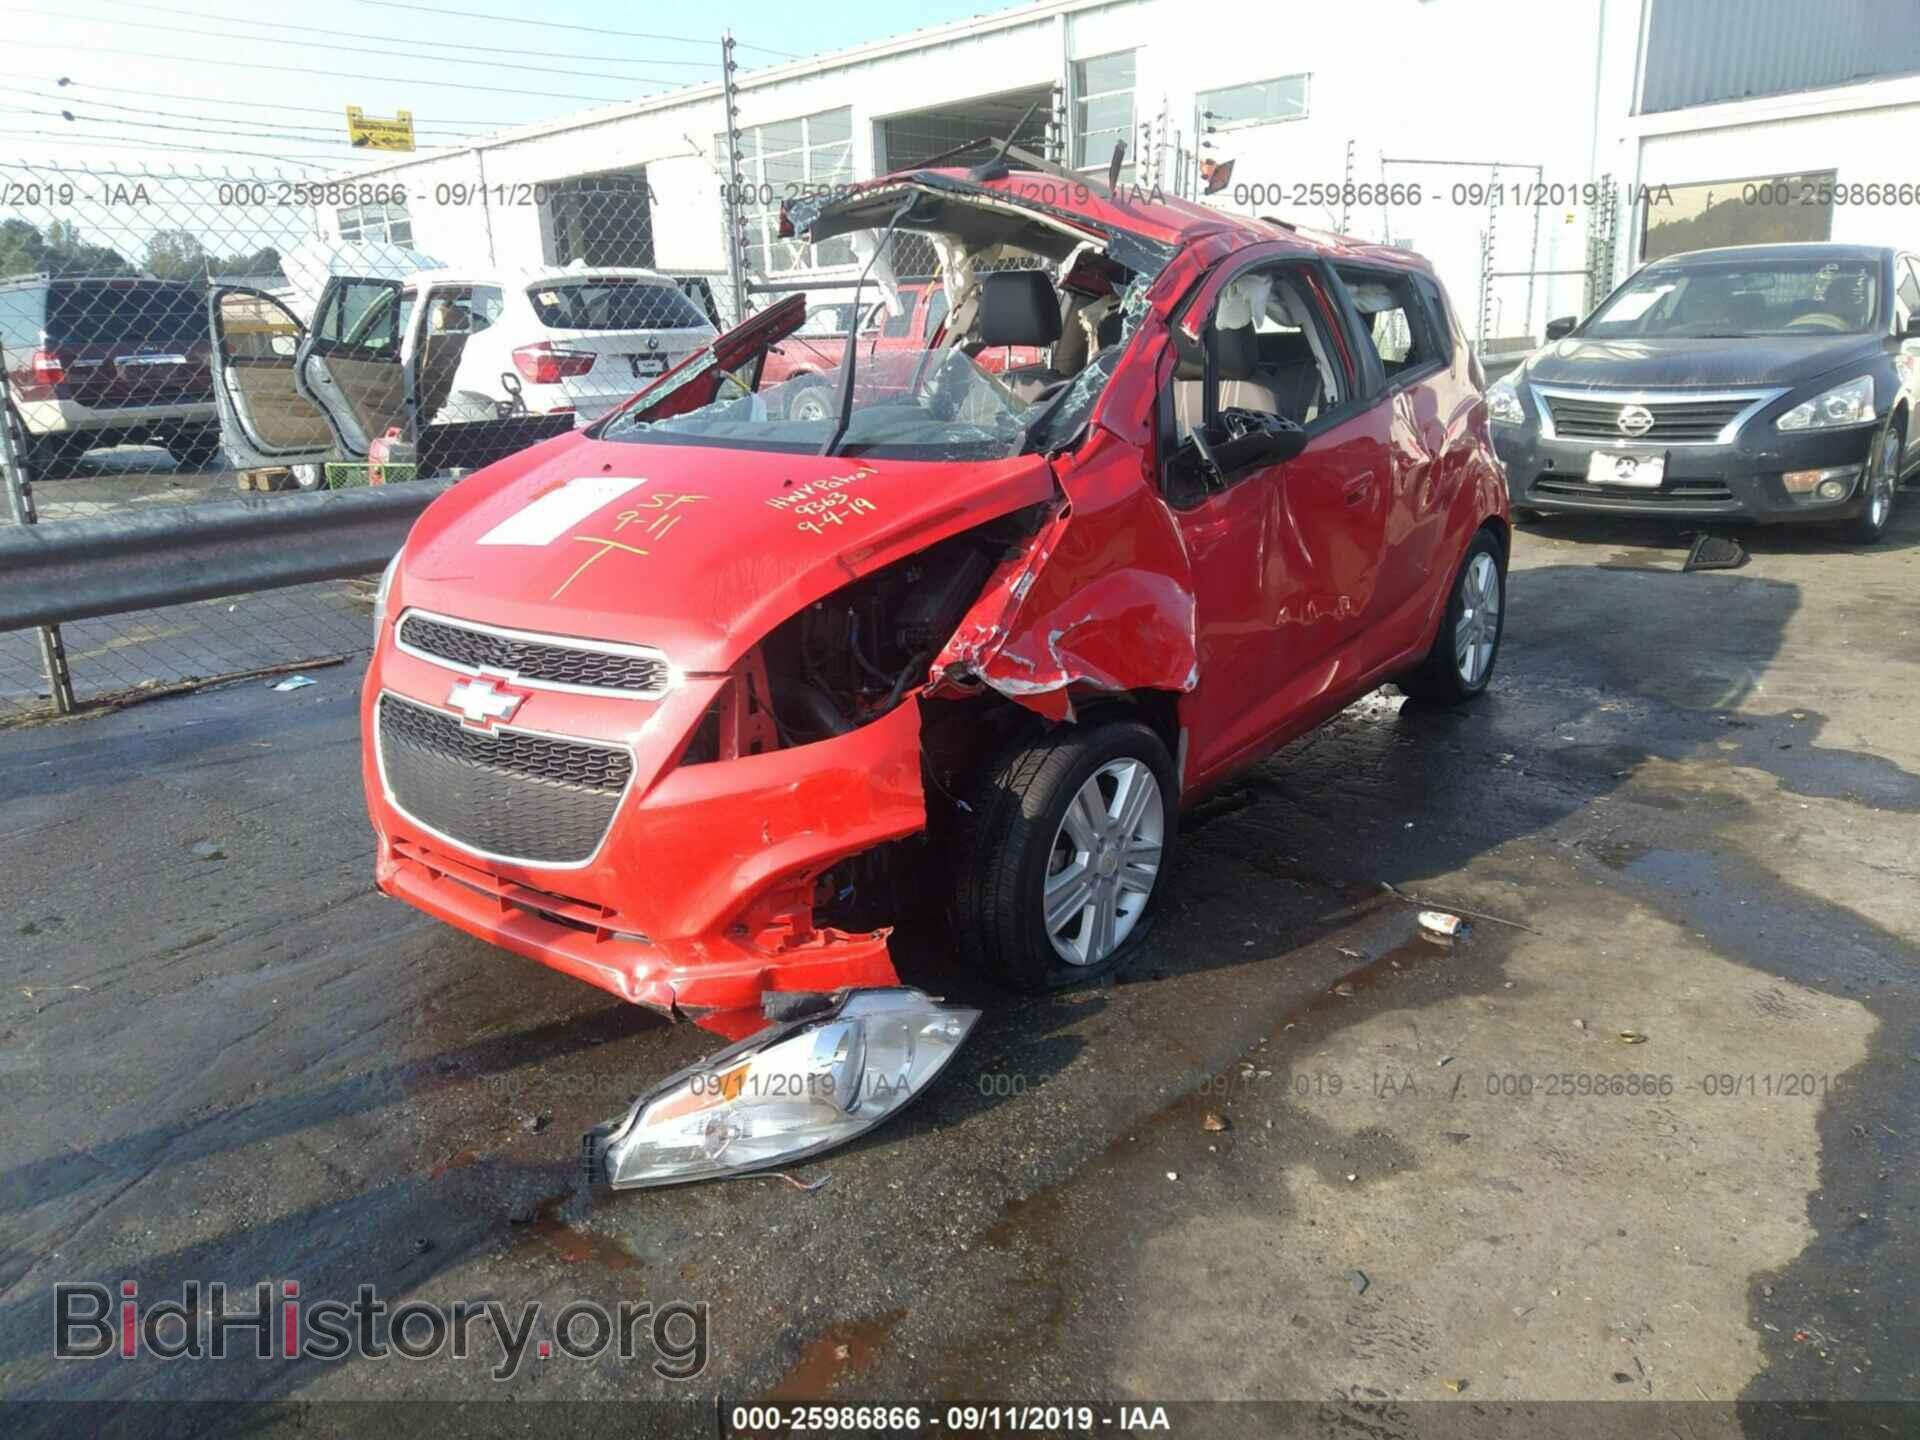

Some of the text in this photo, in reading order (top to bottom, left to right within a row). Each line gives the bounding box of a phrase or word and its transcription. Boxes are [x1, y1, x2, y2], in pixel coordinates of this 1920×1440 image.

[795, 491, 848, 515] 9363
[797, 497, 877, 534] 9-4-19
[612, 510, 682, 541] 9-11
